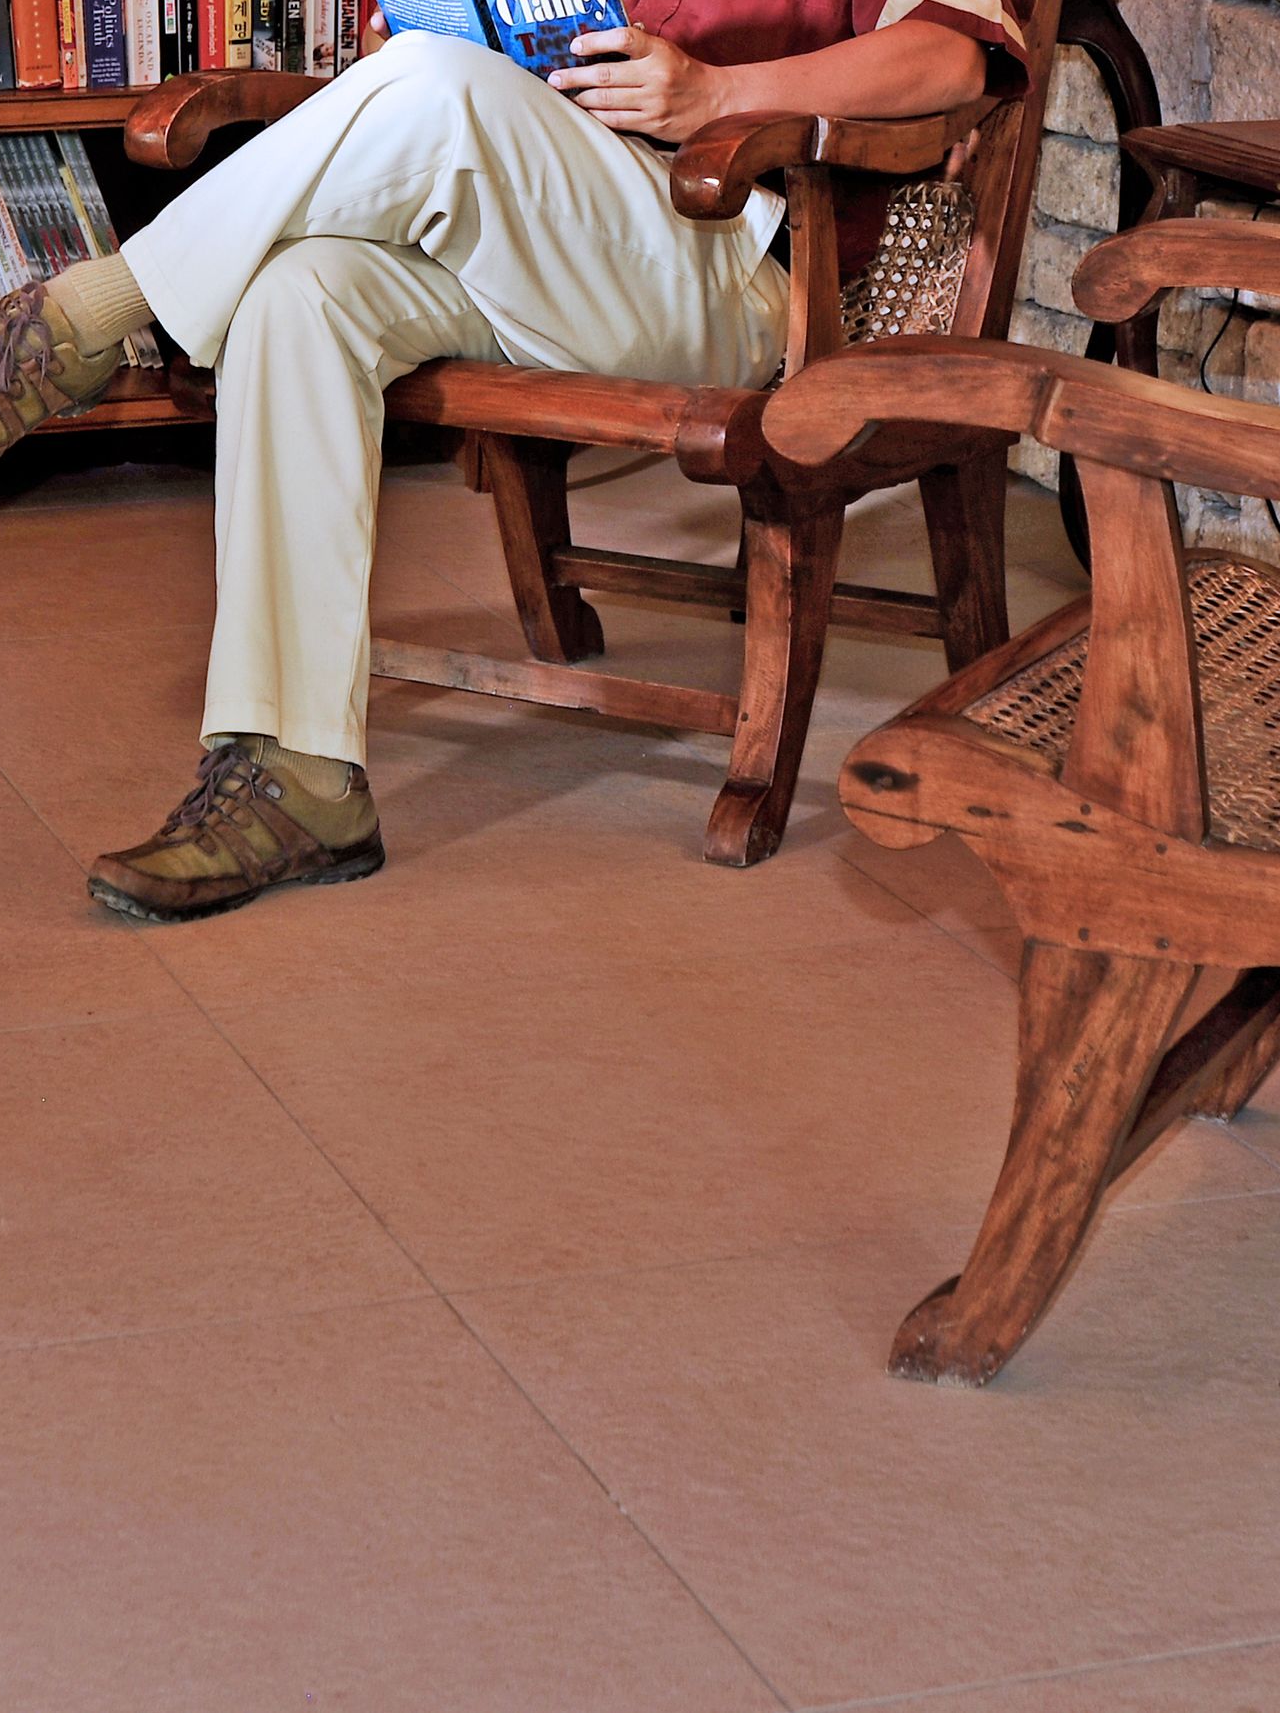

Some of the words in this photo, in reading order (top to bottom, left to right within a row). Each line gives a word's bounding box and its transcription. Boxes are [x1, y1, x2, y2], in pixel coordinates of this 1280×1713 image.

[91, 5, 108, 46] Truth
[135, 17, 145, 66] LUCINDA
[144, 9, 153, 45] OSCAR
[145, 49, 154, 71] AND
